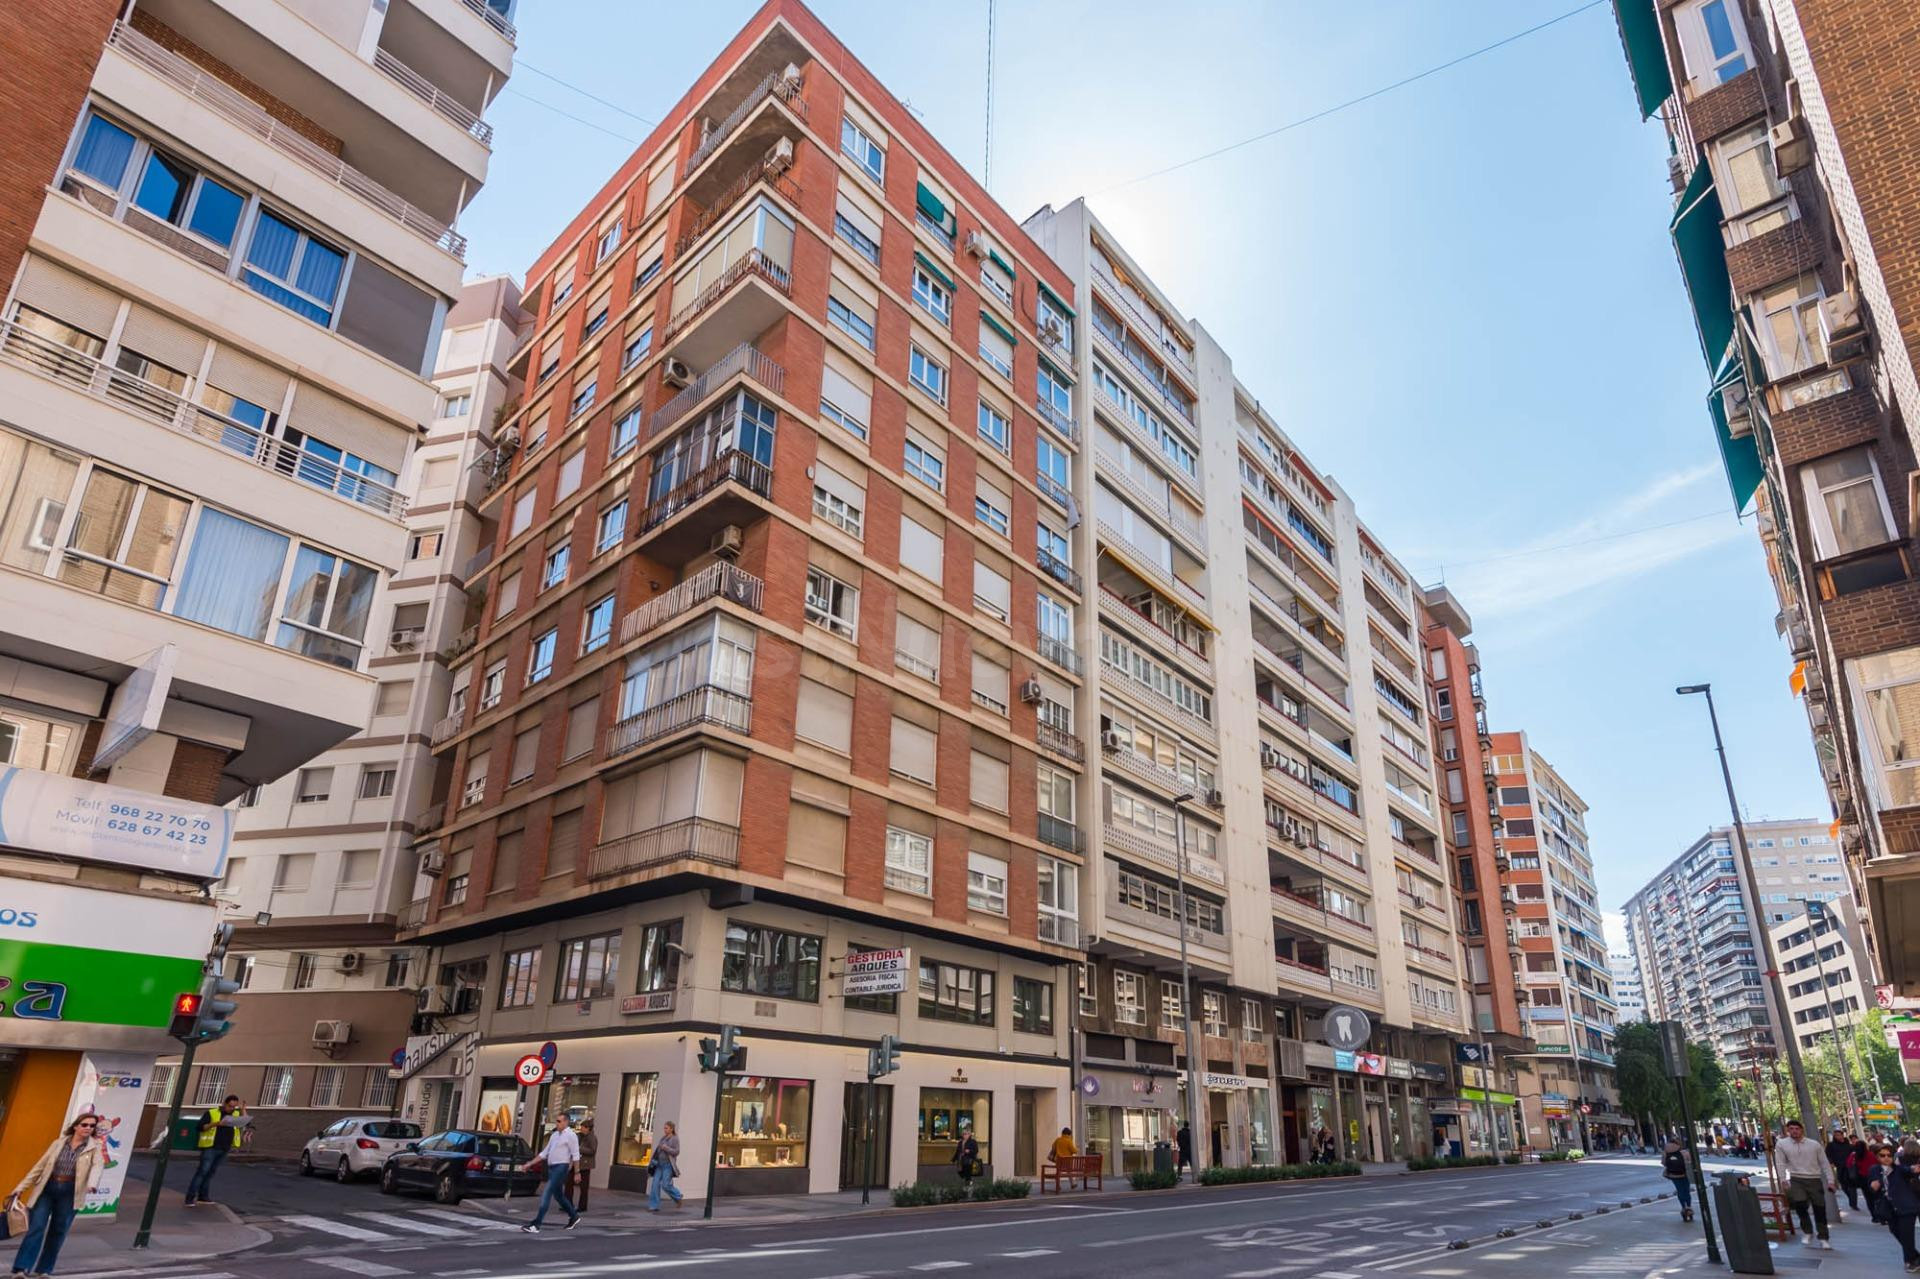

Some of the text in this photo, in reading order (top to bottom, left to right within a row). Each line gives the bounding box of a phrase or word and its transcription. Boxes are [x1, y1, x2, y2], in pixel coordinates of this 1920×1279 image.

[110, 804, 140, 817] 968
[144, 811, 163, 822] 22
[168, 815, 188, 827] 70
[192, 820, 211, 831] 70
[107, 819, 137, 833] 628
[142, 825, 162, 836] 67
[166, 831, 185, 841] 42
[189, 834, 207, 845] 23
[0, 909, 38, 928] os
[848, 950, 903, 964] GESTORIA
[851, 960, 897, 973] ARQUES
[0, 976, 66, 1020] a
[522, 1065, 539, 1076] 30
